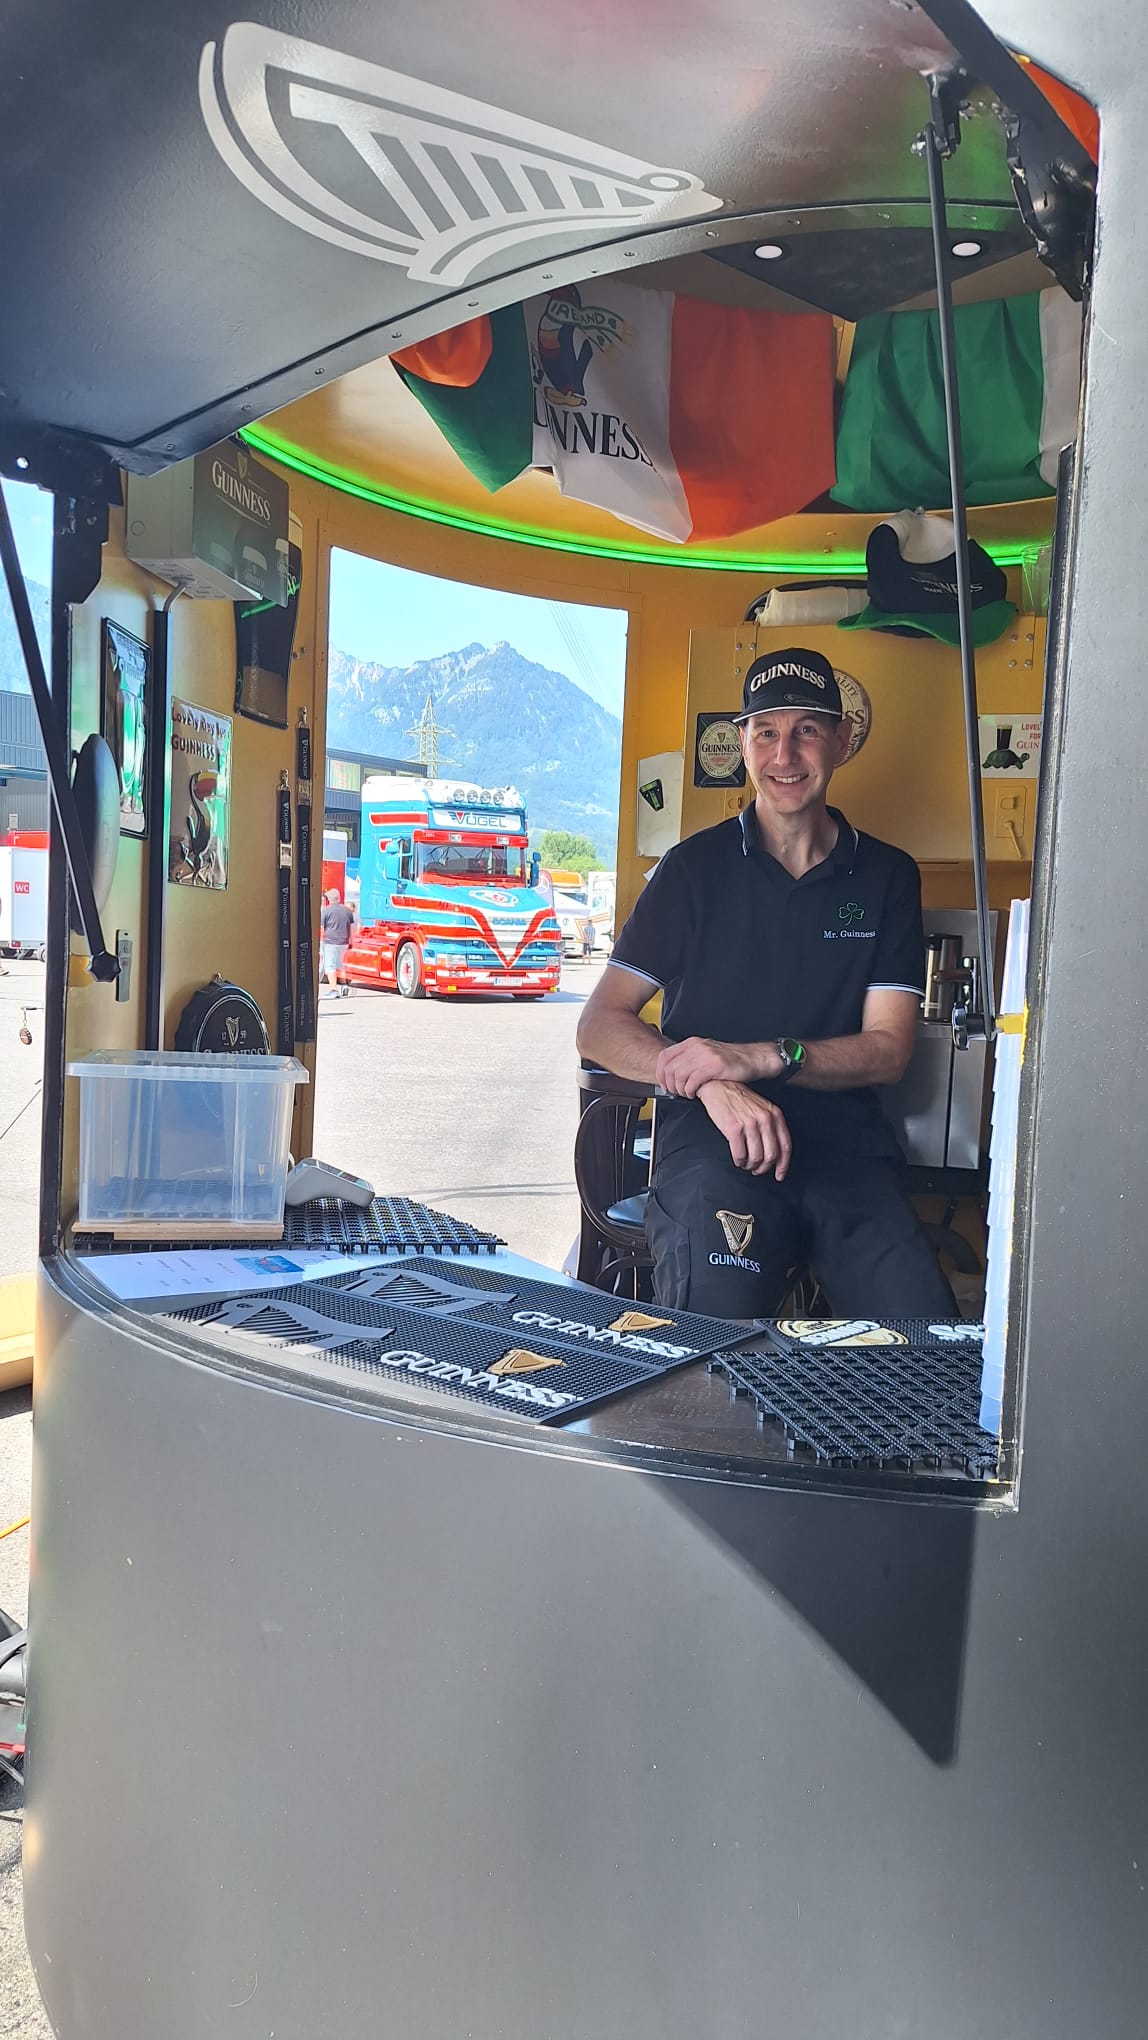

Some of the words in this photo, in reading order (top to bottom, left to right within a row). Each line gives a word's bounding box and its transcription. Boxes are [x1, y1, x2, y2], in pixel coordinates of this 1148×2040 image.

[212, 460, 271, 522] GUINNESS
[750, 662, 825, 693] GUINNESS
[171, 734, 216, 763] GUINNESS
[701, 743, 741, 753] GUINNESS
[15, 884, 29, 893] WC
[823, 930, 838, 939] Mr.
[840, 930, 876, 938] Guinness
[709, 1252, 760, 1273] GUINNESS
[512, 1311, 693, 1359] GUINNESS
[380, 1350, 577, 1408] GUINNESS
